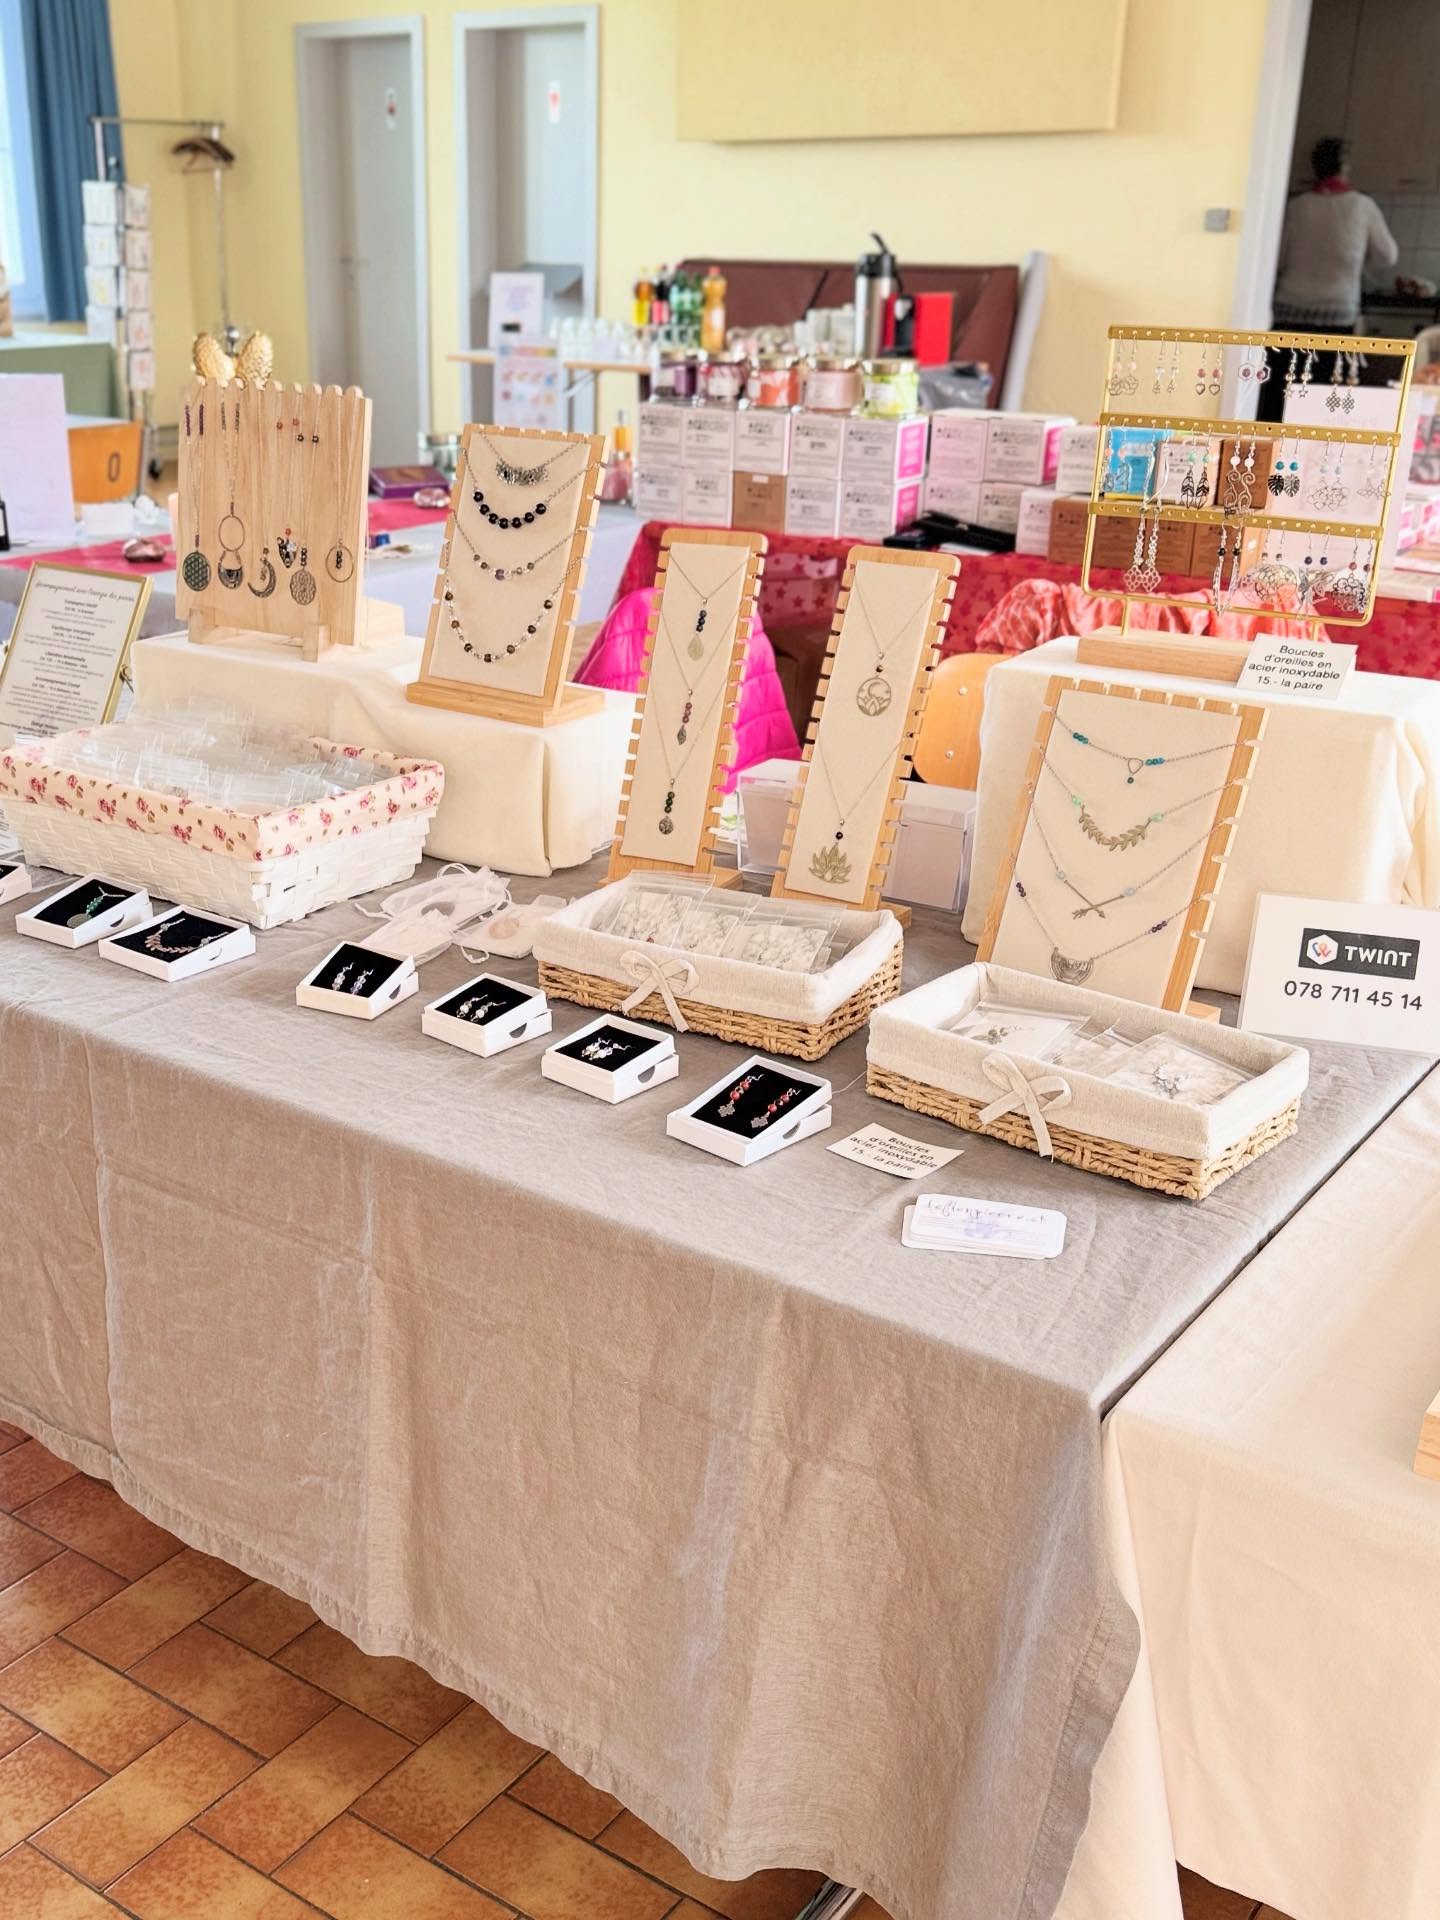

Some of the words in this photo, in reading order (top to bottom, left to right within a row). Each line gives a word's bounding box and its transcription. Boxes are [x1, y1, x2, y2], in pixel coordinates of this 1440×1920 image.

[1279, 645, 1325, 658] Boucles
[1264, 654, 1314, 668] d'oreilles
[1317, 660, 1332, 669] en
[1248, 663, 1277, 672] acier
[1279, 666, 1340, 680] inoxydable
[1281, 679, 1291, 688] la
[1293, 681, 1323, 691] paire
[1344, 945, 1412, 967] TWINT
[1284, 980, 1322, 999] 078
[1331, 985, 1360, 1004] 711
[1366, 990, 1393, 1008] 45
[1400, 994, 1423, 1011] 14
[849, 1136, 877, 1149] acier
[878, 1148, 938, 1168] inoxydable
[888, 1137, 930, 1153] Boucles
[919, 1153, 935, 1161] en
[885, 1160, 915, 1171] paire
